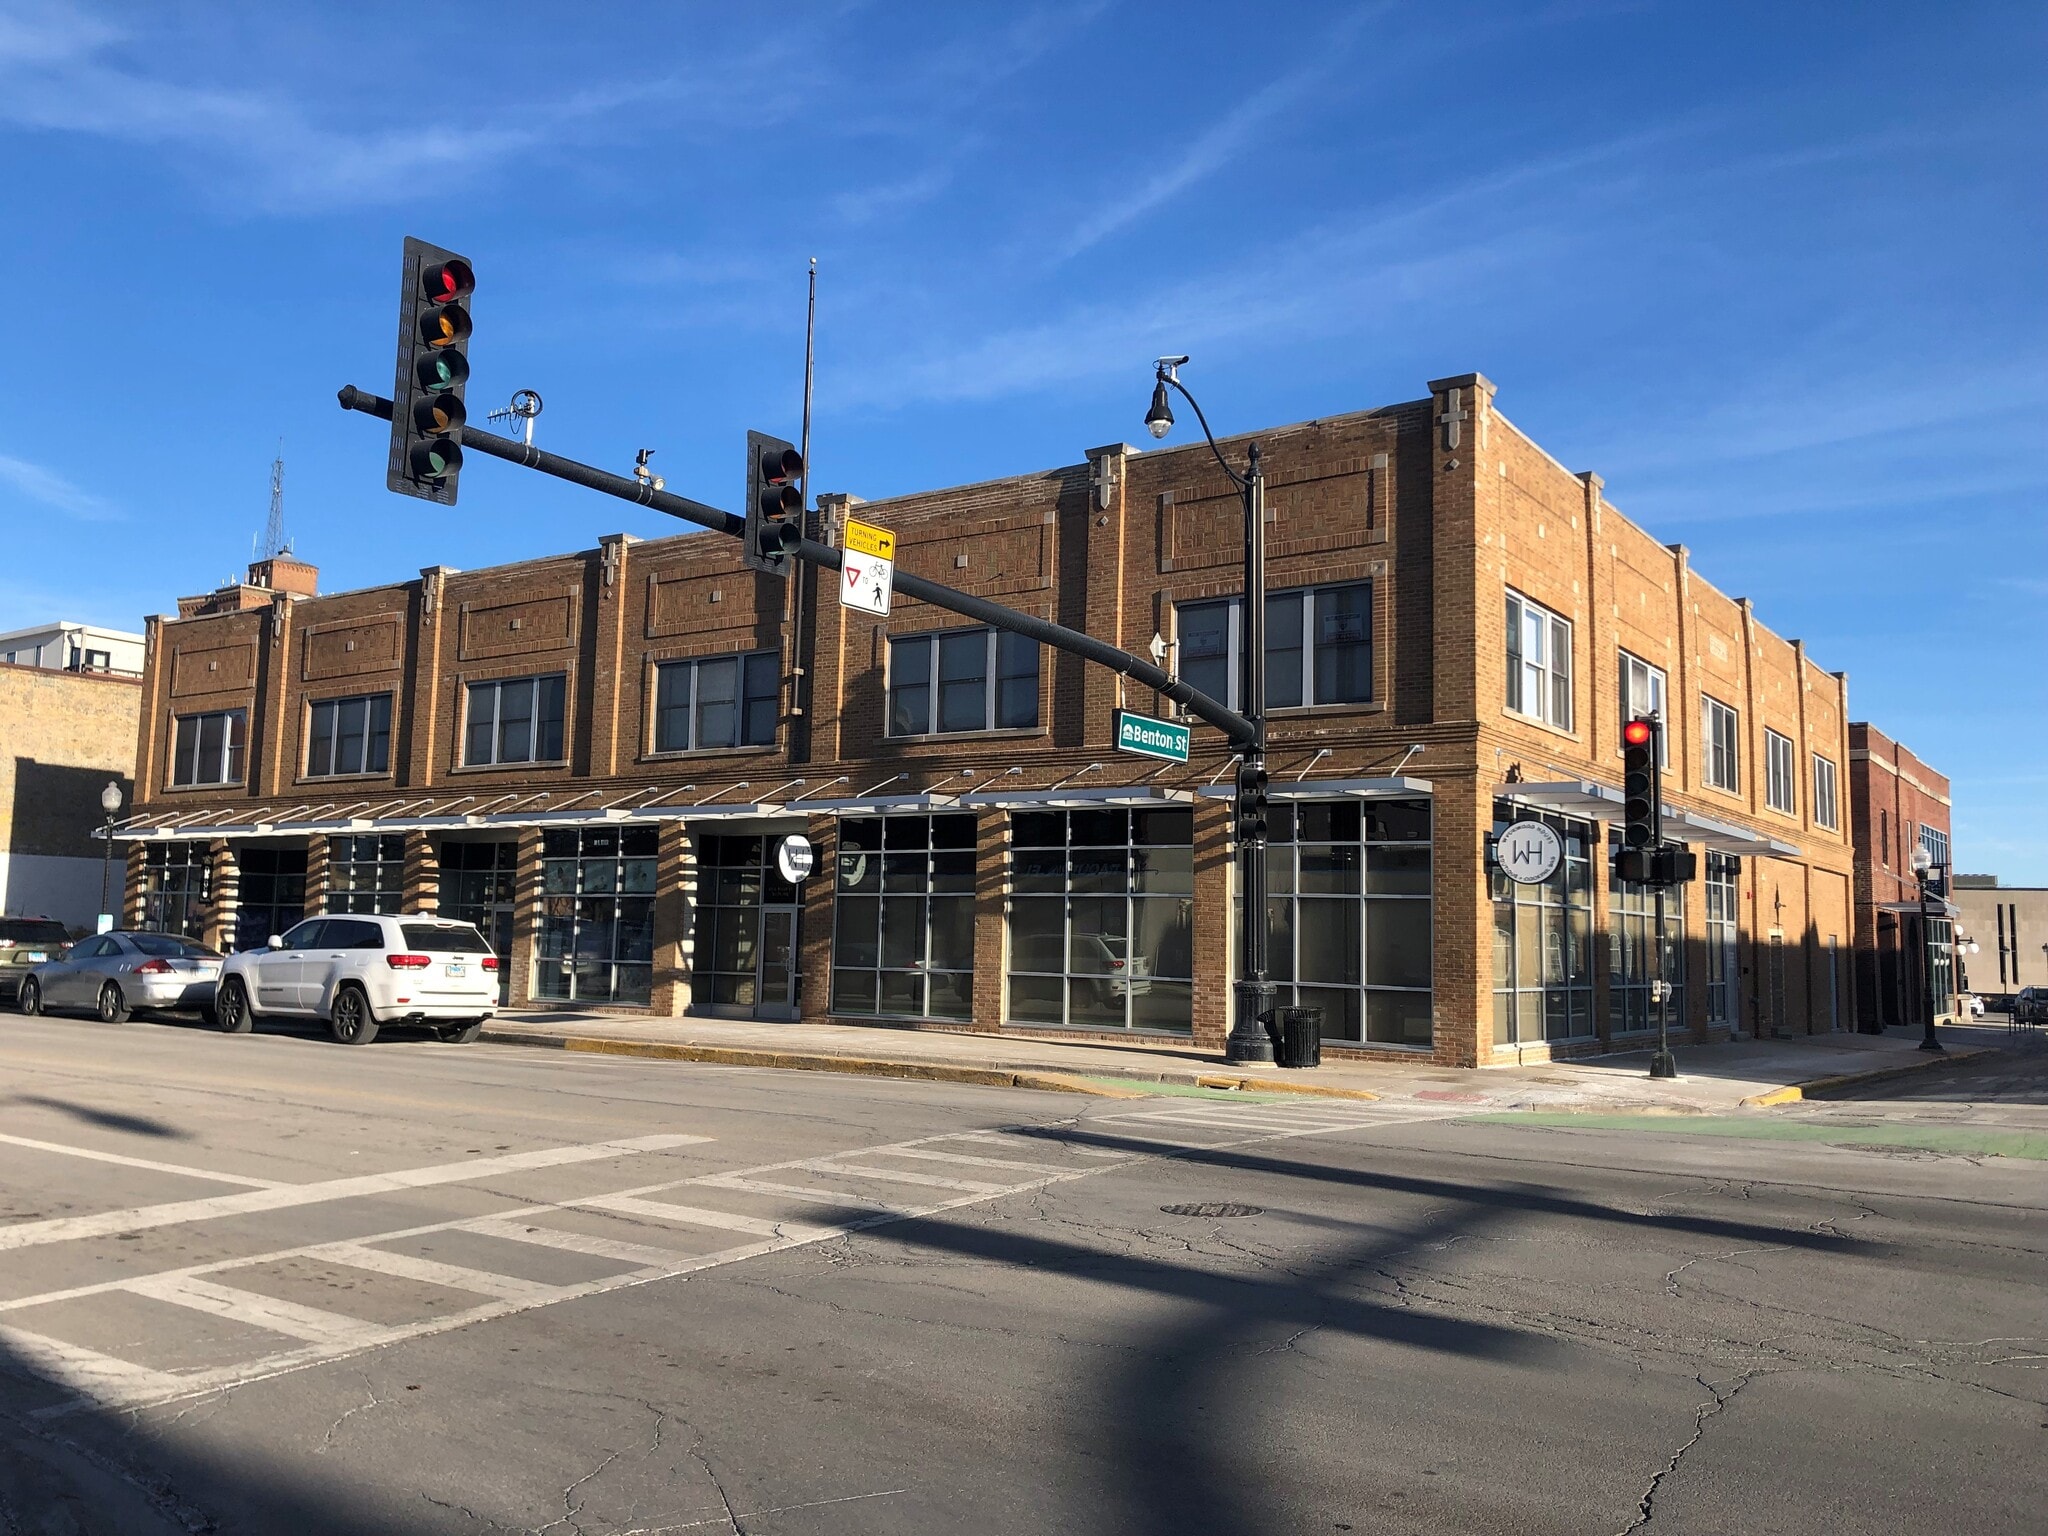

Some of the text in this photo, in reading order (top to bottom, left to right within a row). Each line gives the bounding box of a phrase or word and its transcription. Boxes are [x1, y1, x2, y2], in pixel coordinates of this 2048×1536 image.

[851, 527, 877, 541] TURNING
[849, 537, 878, 552] VEHICLES
[862, 576, 869, 584] TO
[1134, 725, 1187, 752] Benton St
[1512, 840, 1543, 865] WH
